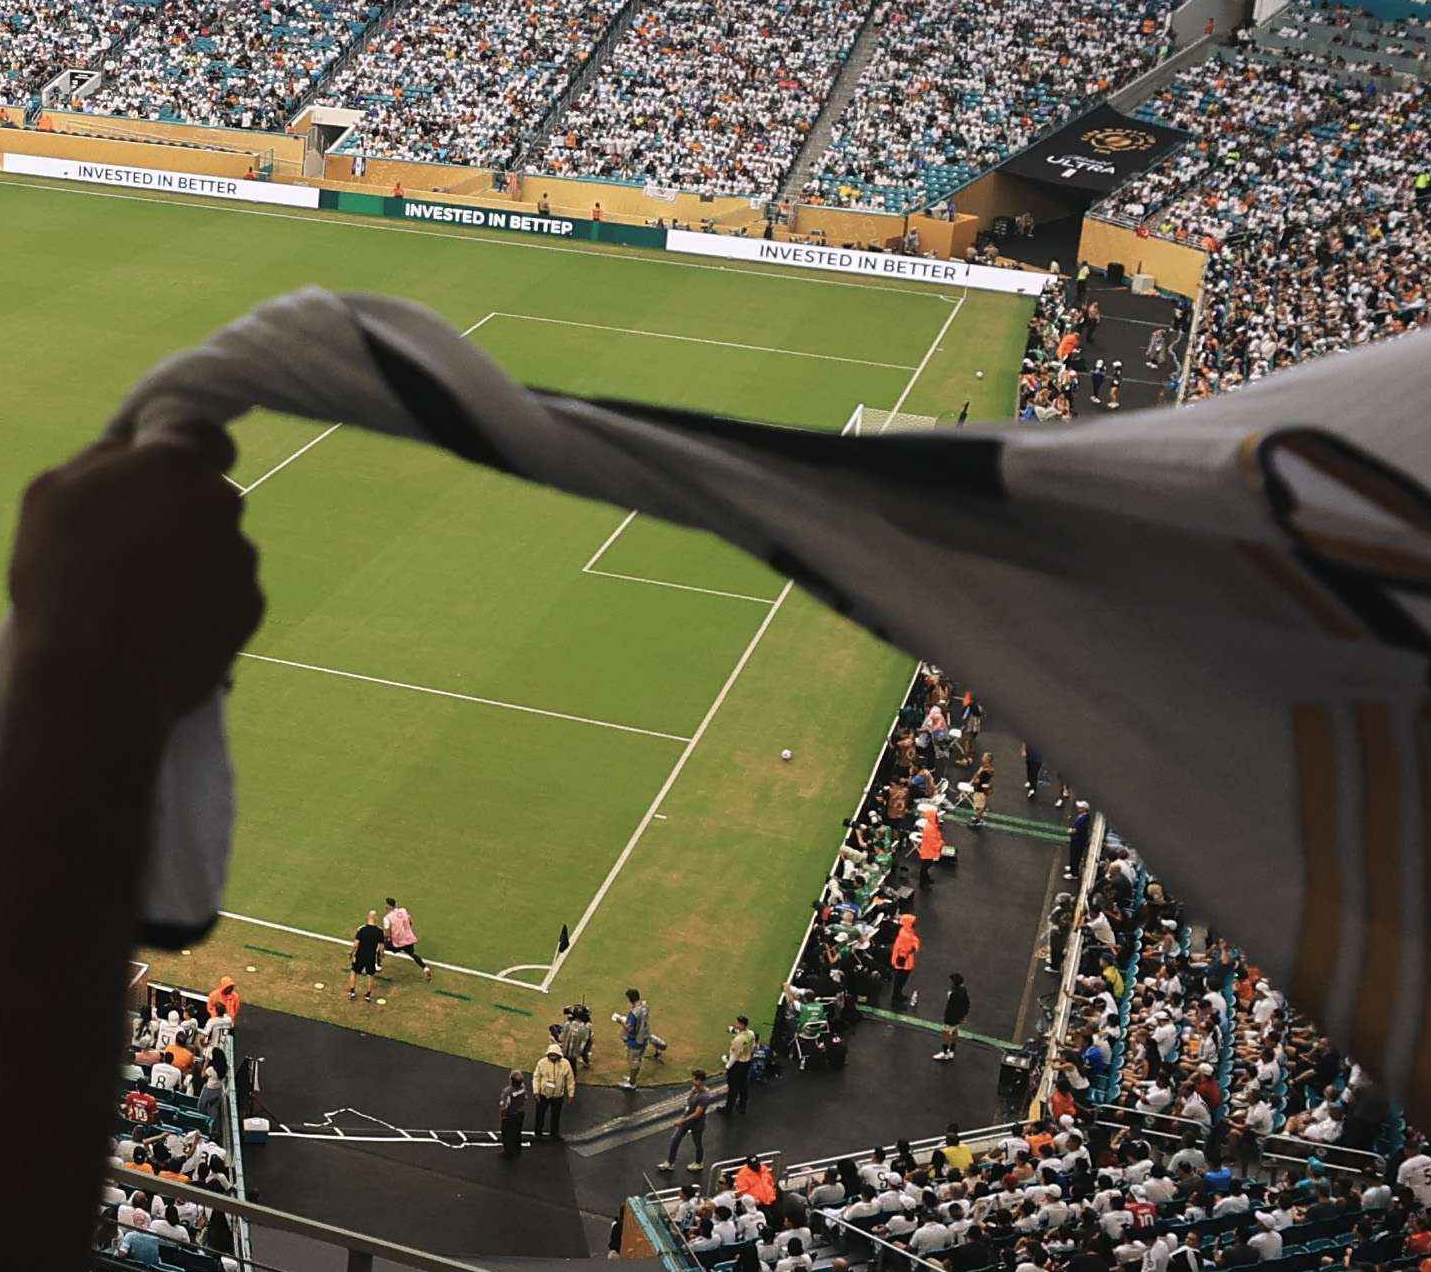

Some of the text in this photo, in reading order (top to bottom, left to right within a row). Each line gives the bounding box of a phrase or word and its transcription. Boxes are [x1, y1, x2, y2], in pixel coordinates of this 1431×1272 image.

[78, 166, 237, 195] INVESTED IN BETTER
[404, 203, 484, 225] INVESTED
[489, 212, 506, 228] IN
[759, 244, 956, 281] INVESTED IN BETTER
